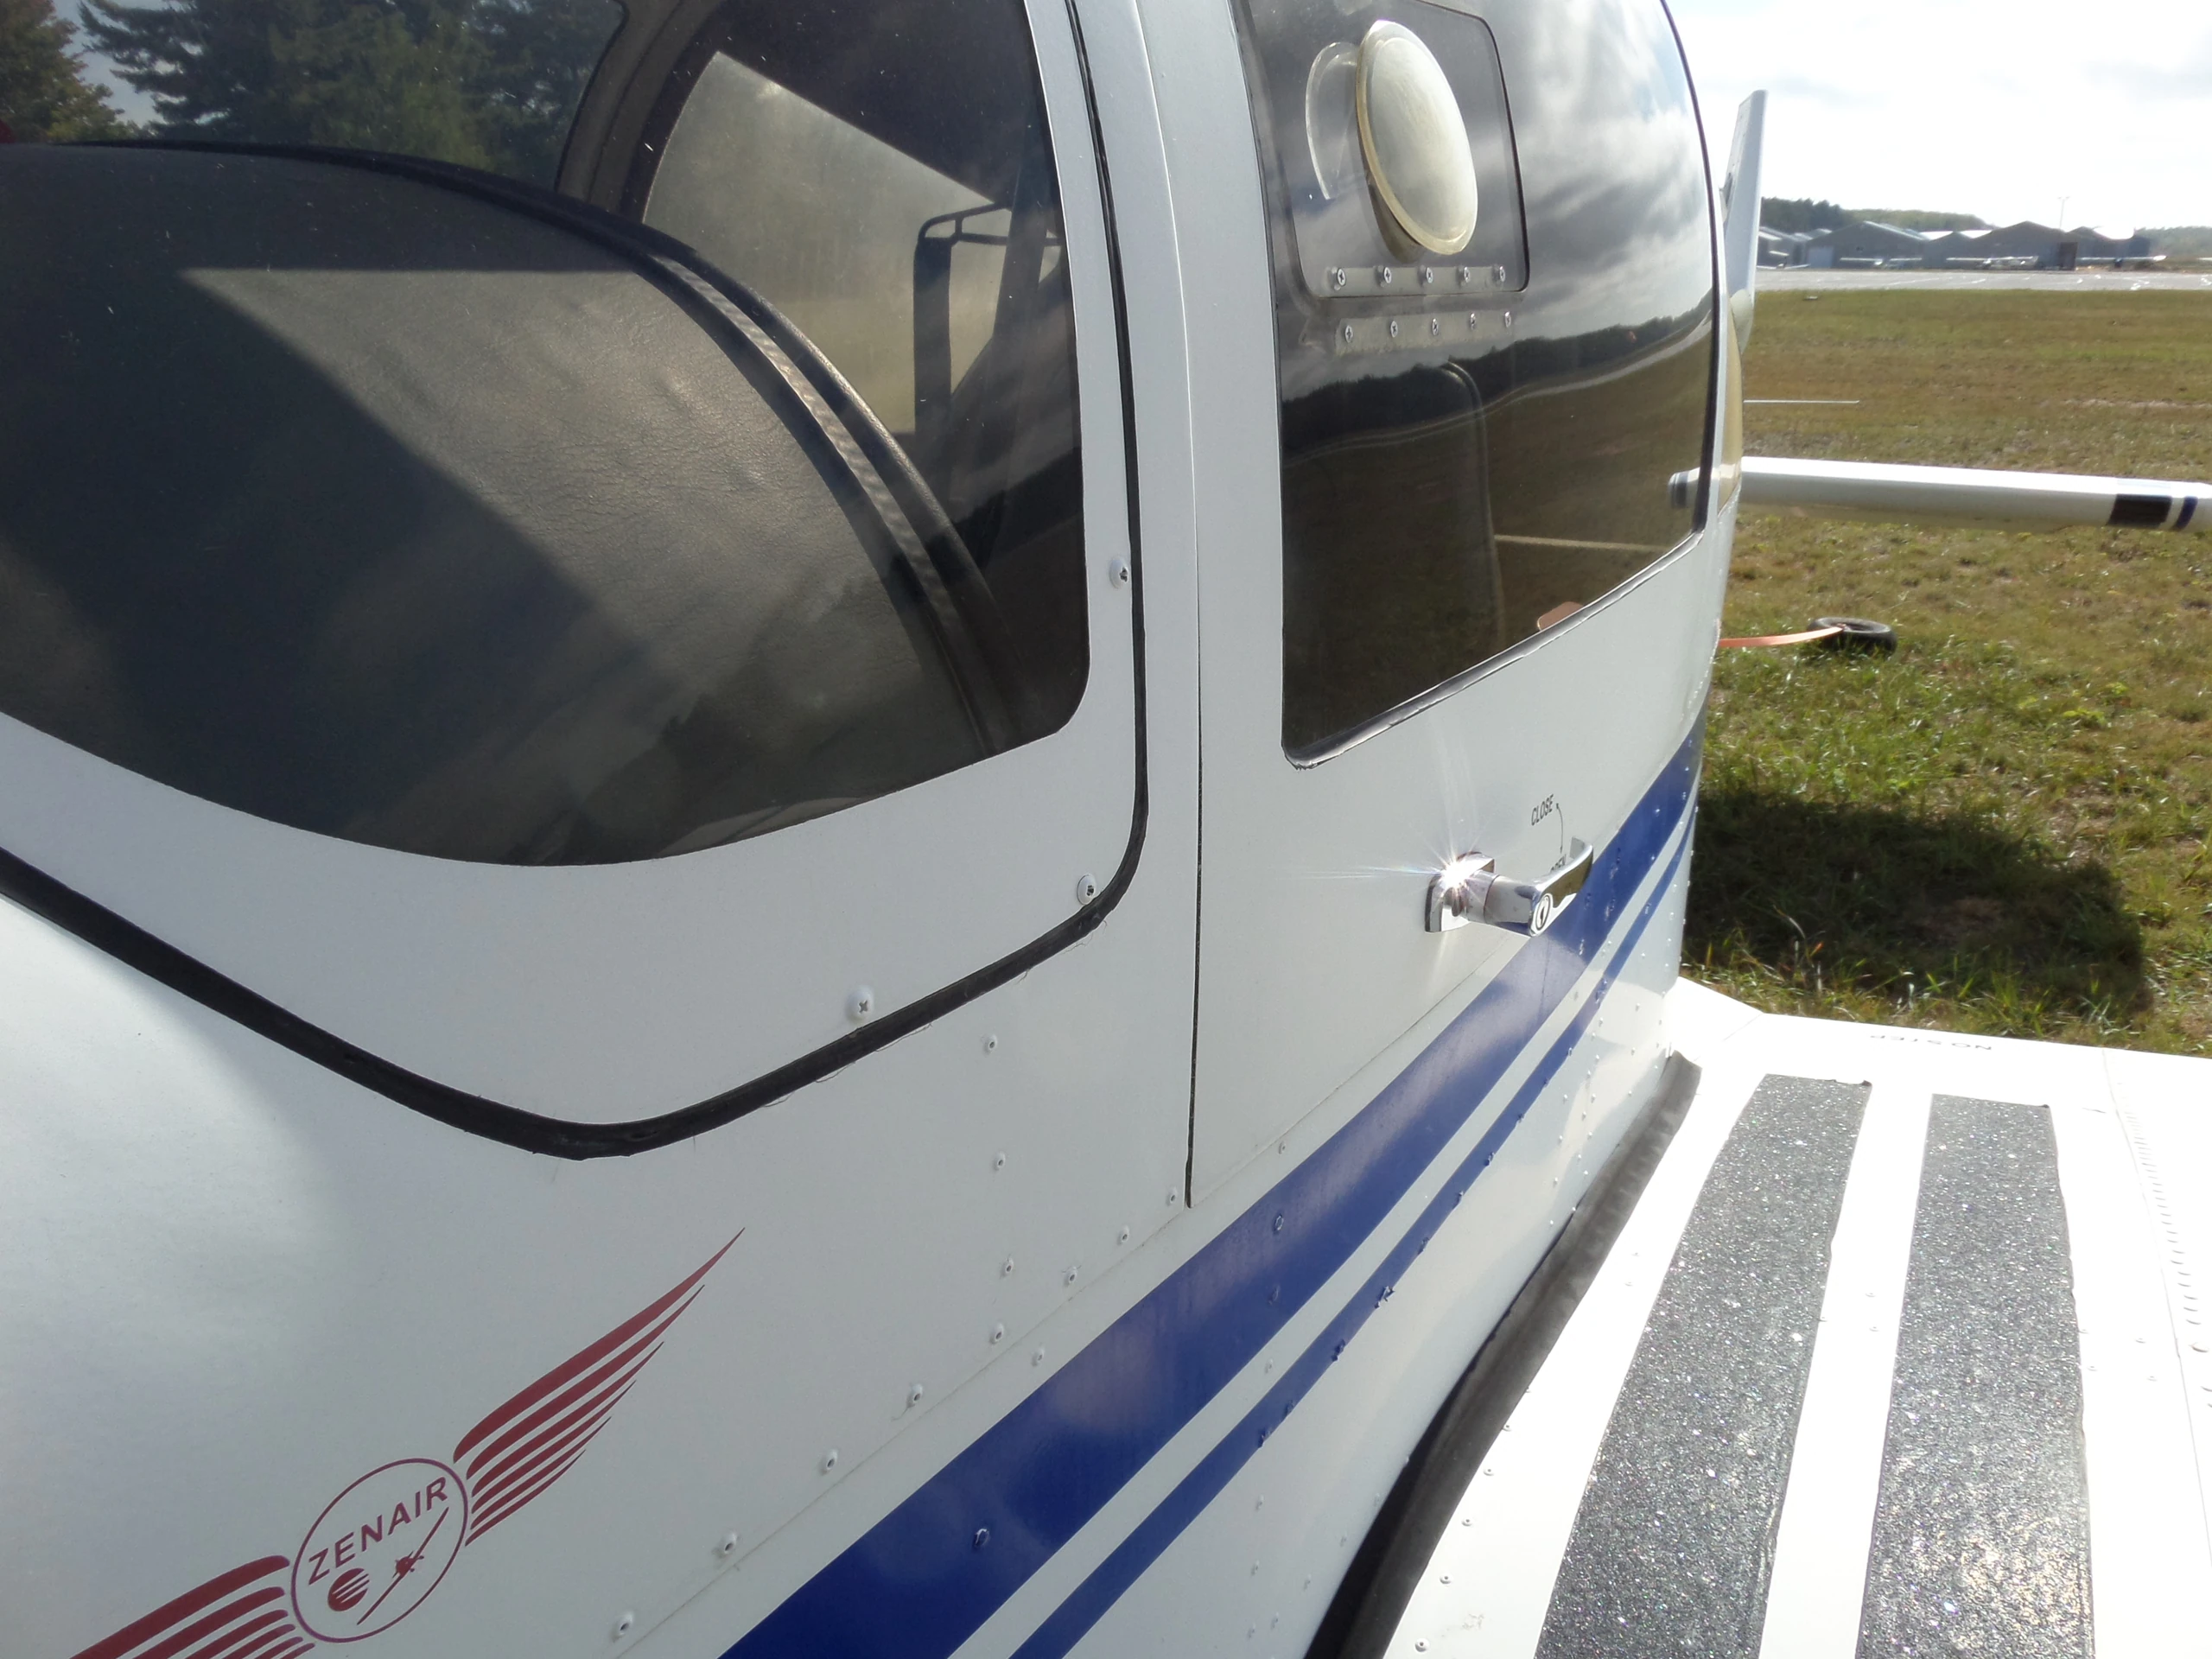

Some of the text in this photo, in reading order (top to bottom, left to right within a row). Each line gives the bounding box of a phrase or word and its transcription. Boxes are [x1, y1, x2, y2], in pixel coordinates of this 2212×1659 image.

[1531, 793, 1554, 826] CLOSE
[1951, 1042, 1992, 1051] NO
[308, 1476, 448, 1586] ZENAIR
